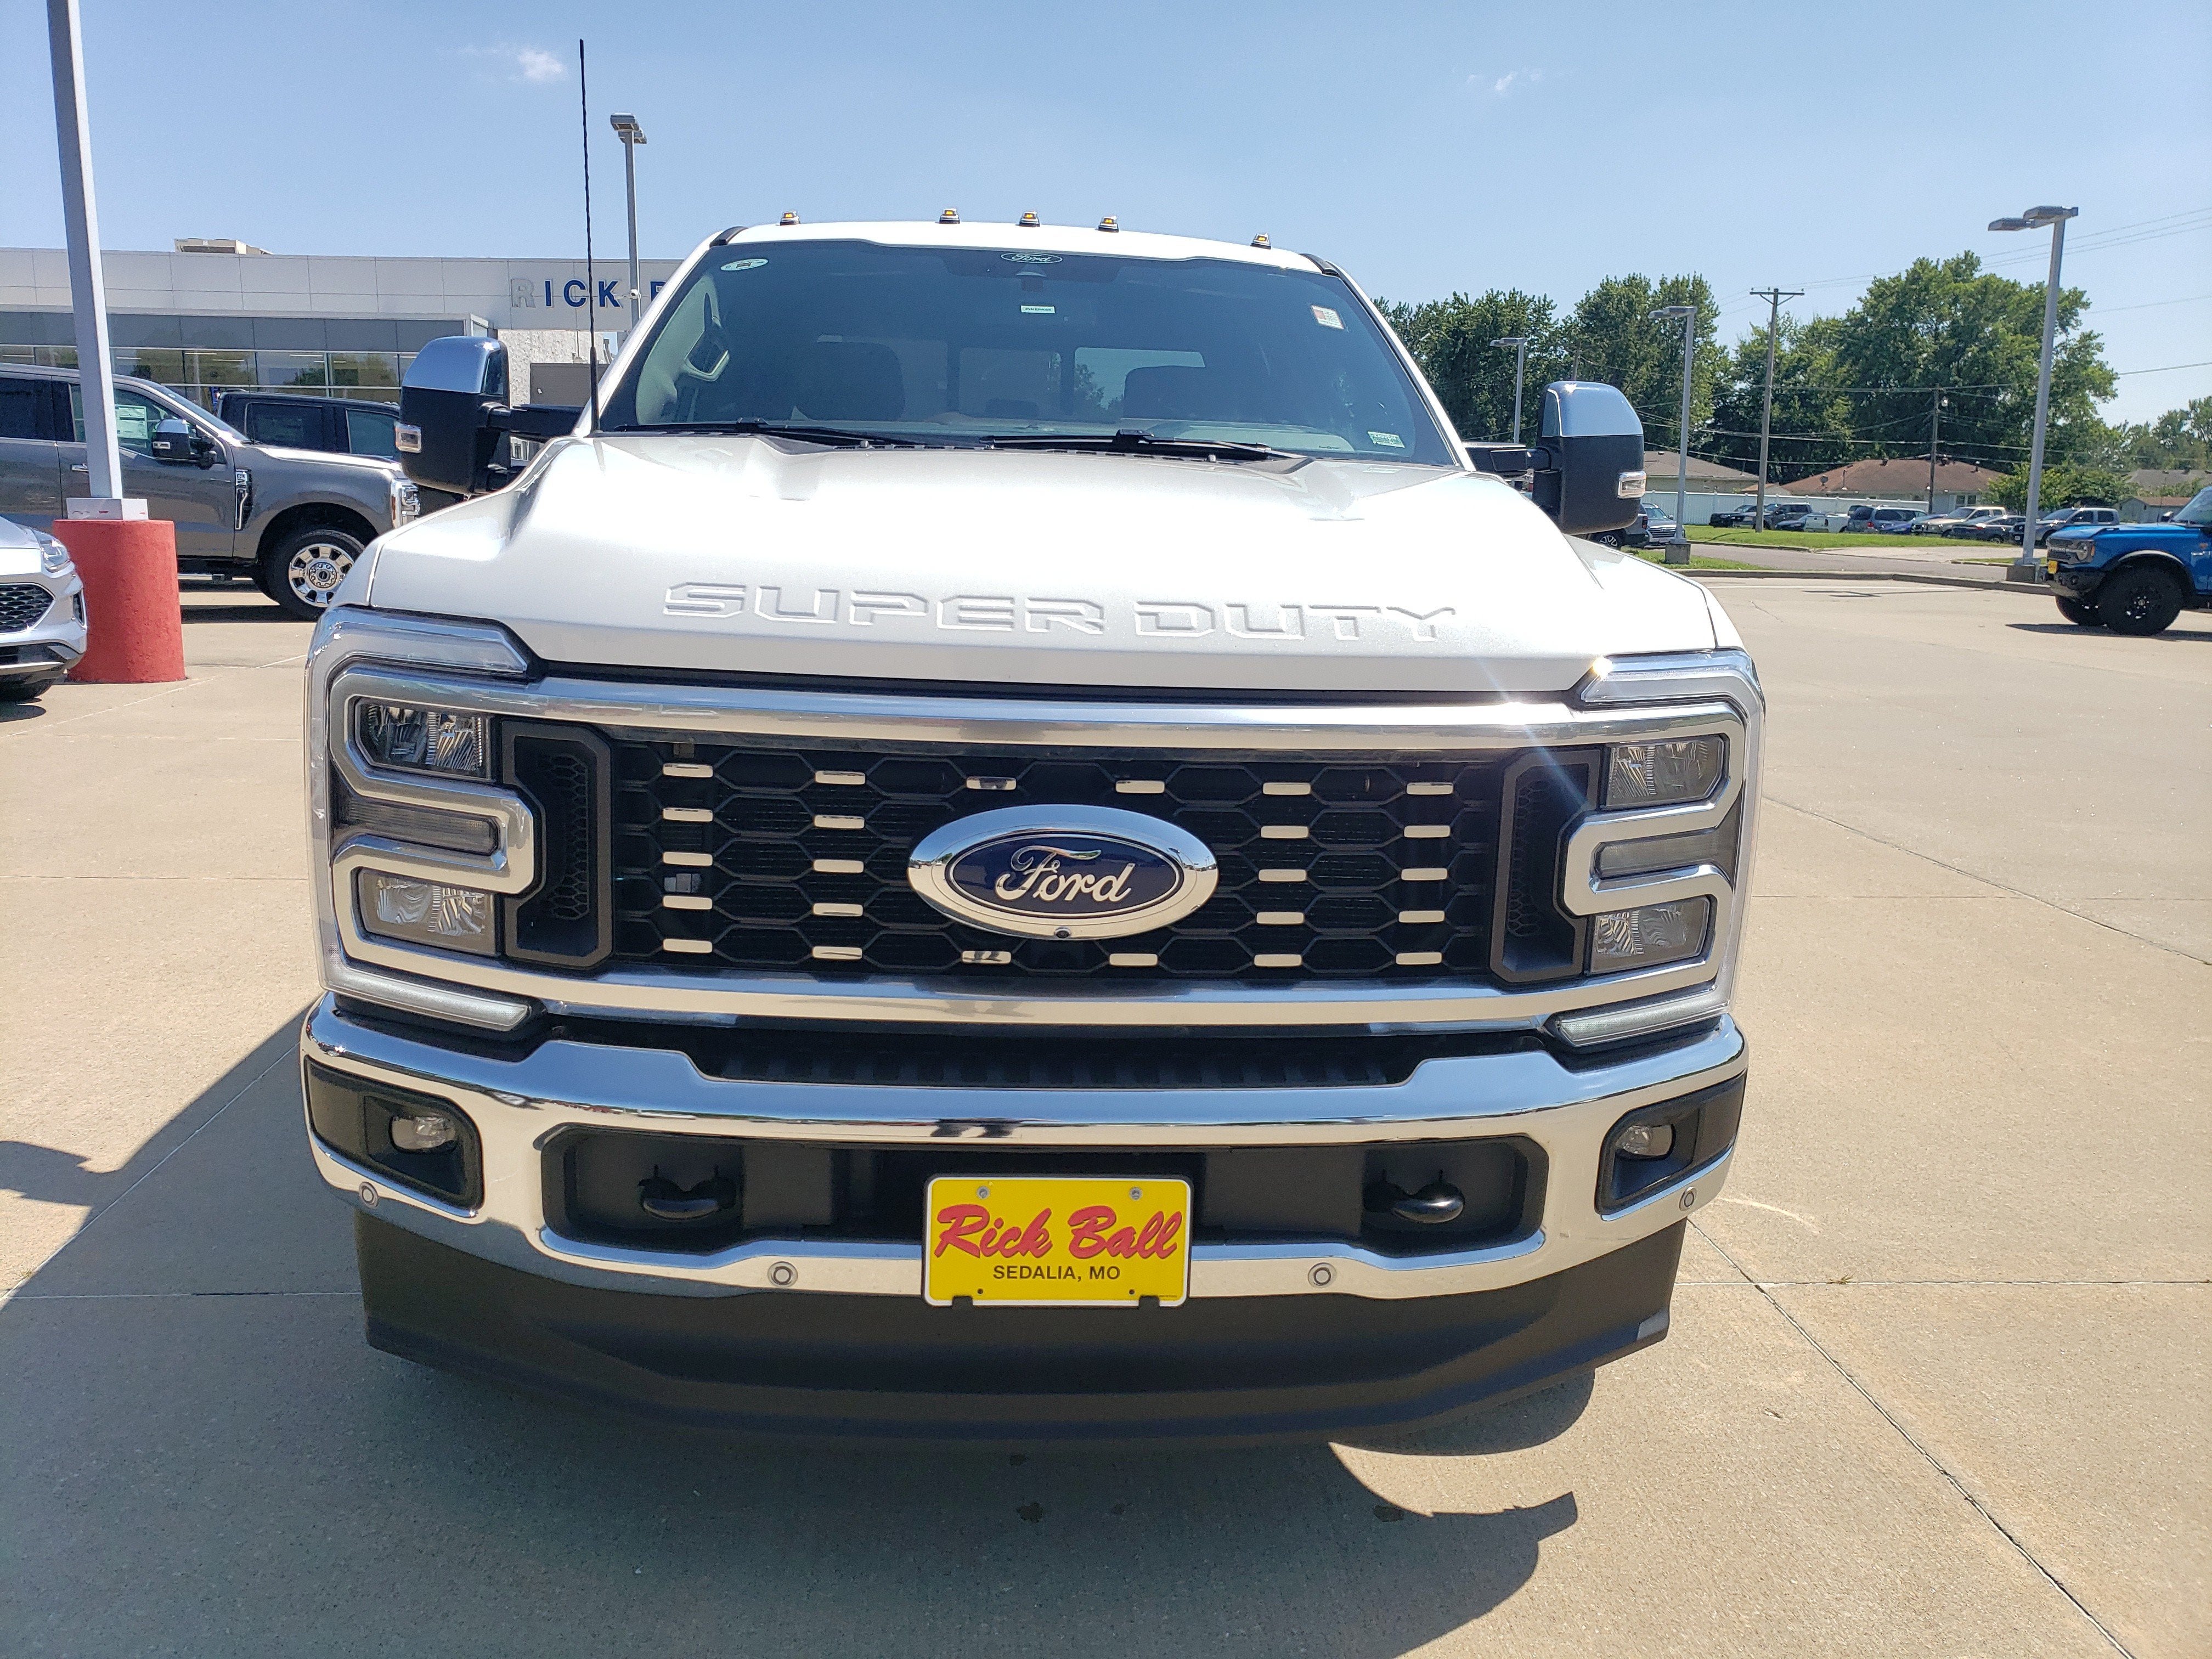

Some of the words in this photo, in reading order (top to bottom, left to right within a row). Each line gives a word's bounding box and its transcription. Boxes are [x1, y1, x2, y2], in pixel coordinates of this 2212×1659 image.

[1011, 253, 1052, 262] Ford
[511, 279, 623, 308] RICK
[663, 581, 1105, 635] SUPER
[1135, 601, 1455, 641] DUTY
[995, 845, 1136, 902] Ford
[934, 1203, 1053, 1259] Rick
[1068, 1205, 1182, 1259] Ball
[993, 1265, 1082, 1282] SEDALIA,
[1089, 1265, 1121, 1280] MO
